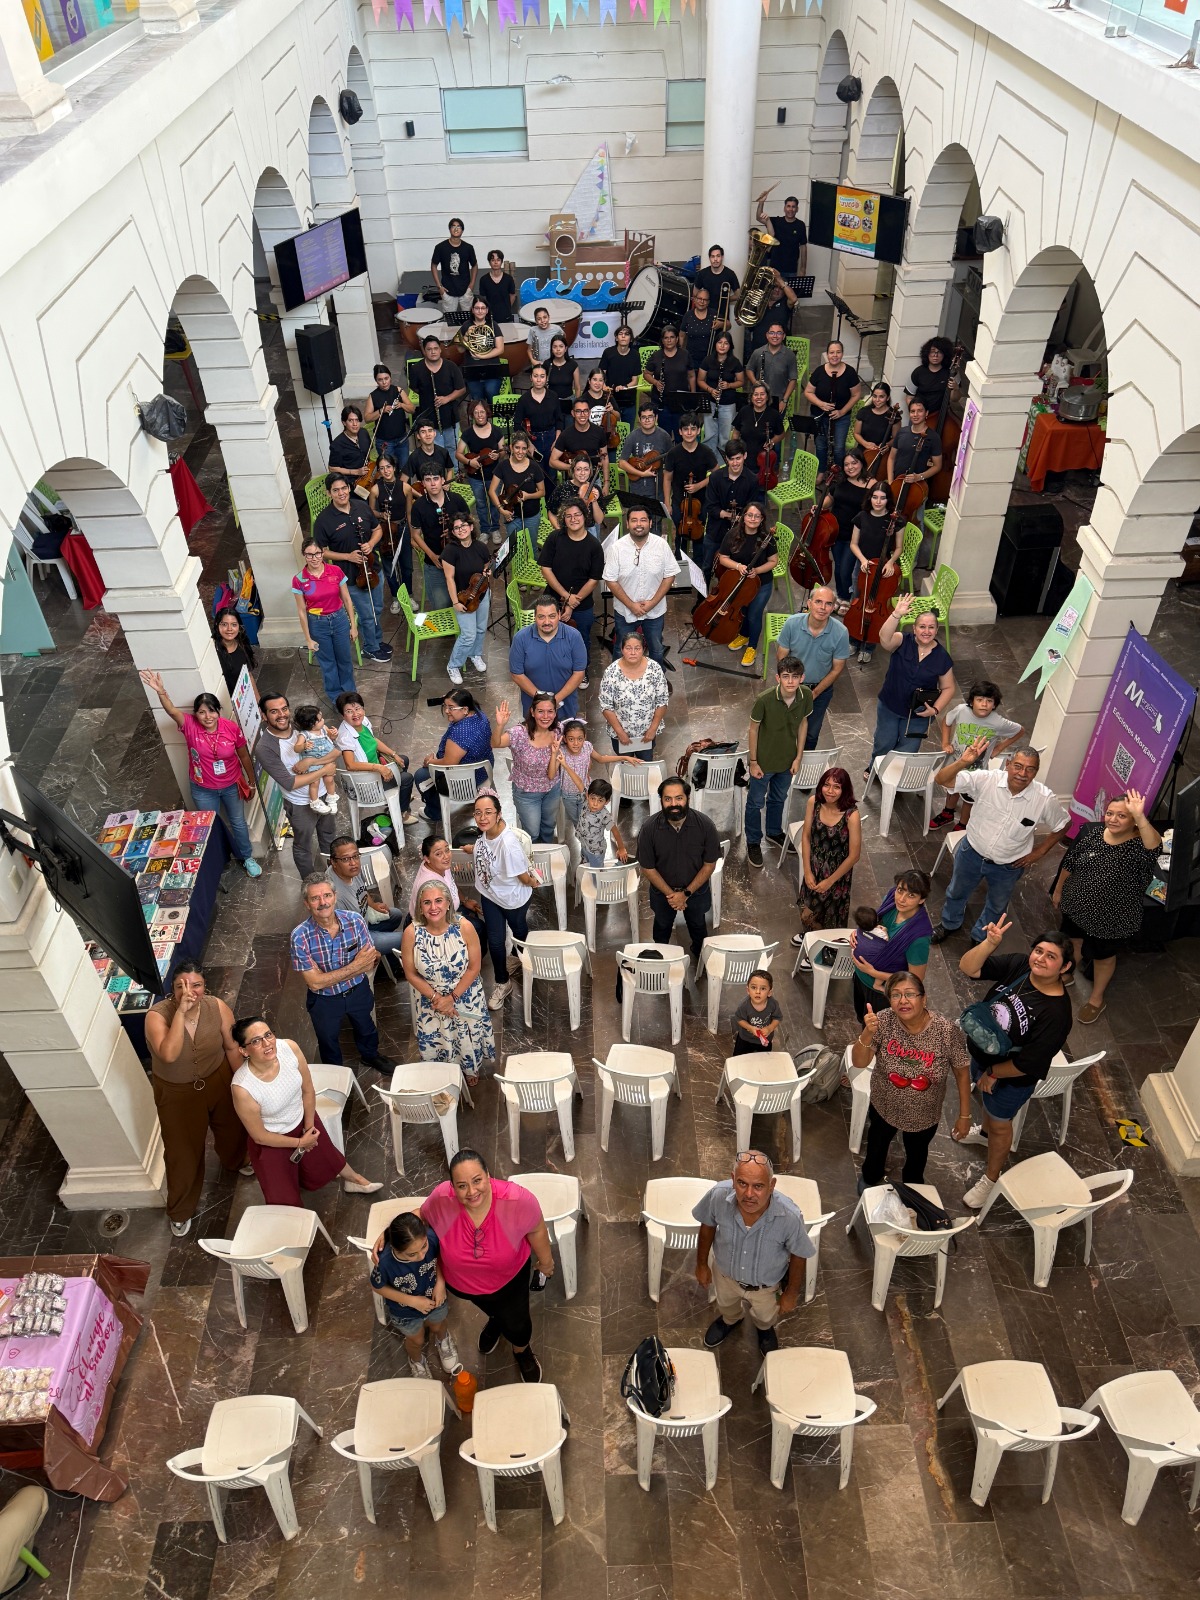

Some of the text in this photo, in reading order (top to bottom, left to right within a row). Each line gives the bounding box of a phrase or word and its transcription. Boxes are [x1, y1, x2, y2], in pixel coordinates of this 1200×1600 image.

[1112, 706, 1134, 738] Ediciones
[1134, 733, 1157, 764] Morgana
[1008, 993, 1029, 1036] ANGELES
[886, 1039, 935, 1068] Cherry
